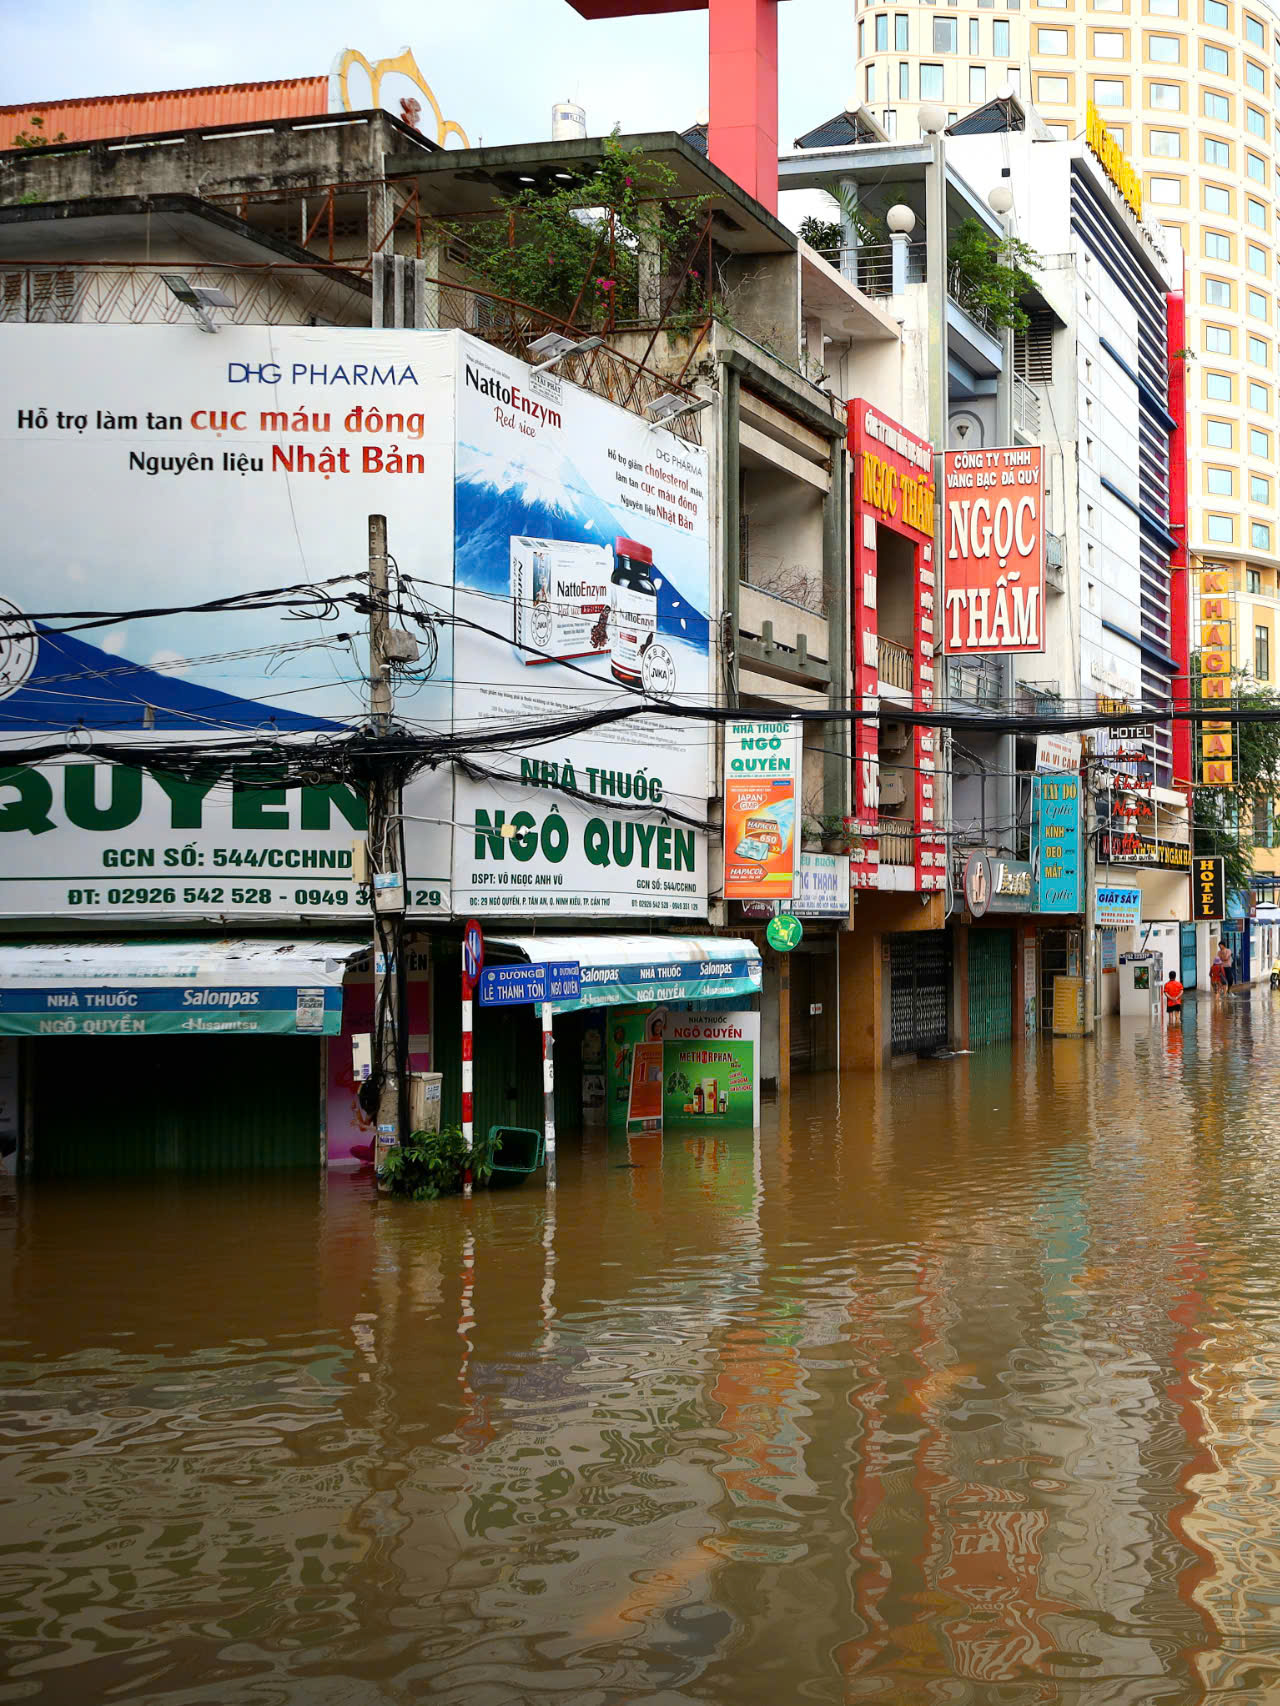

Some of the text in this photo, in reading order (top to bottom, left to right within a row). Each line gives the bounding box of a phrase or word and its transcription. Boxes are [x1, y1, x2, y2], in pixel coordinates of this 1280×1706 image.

[228, 363, 418, 385] DHG PHARMA
[466, 363, 561, 429] NattoEnzym
[17, 405, 425, 439] Hỗ trợ làm tan cục máu đông
[494, 406, 536, 438] Red rice
[129, 444, 425, 480] Nguyên liệu Nhật Bản
[672, 455, 702, 477] PHARMA
[955, 452, 1031, 469] CÔNG TY TNHH
[645, 463, 689, 491] cholesterol
[947, 466, 1039, 491] VÀNG BẠC ĐÁ QUÝ
[948, 495, 1036, 568] NGỌC
[557, 581, 607, 601] NattoEnzym
[741, 734, 782, 751] NGÔ
[1111, 727, 1152, 739] HOTEL
[731, 753, 791, 772] QUYỀN
[521, 759, 663, 803] NHÀ THUỐC
[738, 794, 763, 802] JAPAN
[475, 804, 695, 872] NGÔ QUYỀN
[760, 834, 777, 845] 650
[103, 848, 155, 868] GCN
[164, 841, 204, 868] SỐ:
[471, 873, 495, 885] DSPT:
[510, 873, 533, 887] NGỌC
[535, 874, 552, 886] ANH
[636, 879, 651, 890] GCN
[1200, 860, 1215, 916] HOTEL
[68, 888, 100, 906] ĐT:
[108, 888, 178, 905] 02926
[183, 888, 226, 905] 542
[231, 889, 272, 905] 528
[294, 889, 349, 906] 0949
[1098, 891, 1120, 906] GIẶT
[580, 968, 620, 984] Salonpas
[640, 967, 656, 979] NHÀ
[699, 962, 732, 978] Salonpas
[47, 989, 260, 1008] NHÀ THUỐC Salonpas
[485, 981, 545, 1001] LÊ THÁNH TÔN
[39, 1017, 77, 1033] NGÔ
[674, 1024, 742, 1039] NGÔ QUYỀN
[680, 1051, 733, 1064] METHORPHAN
